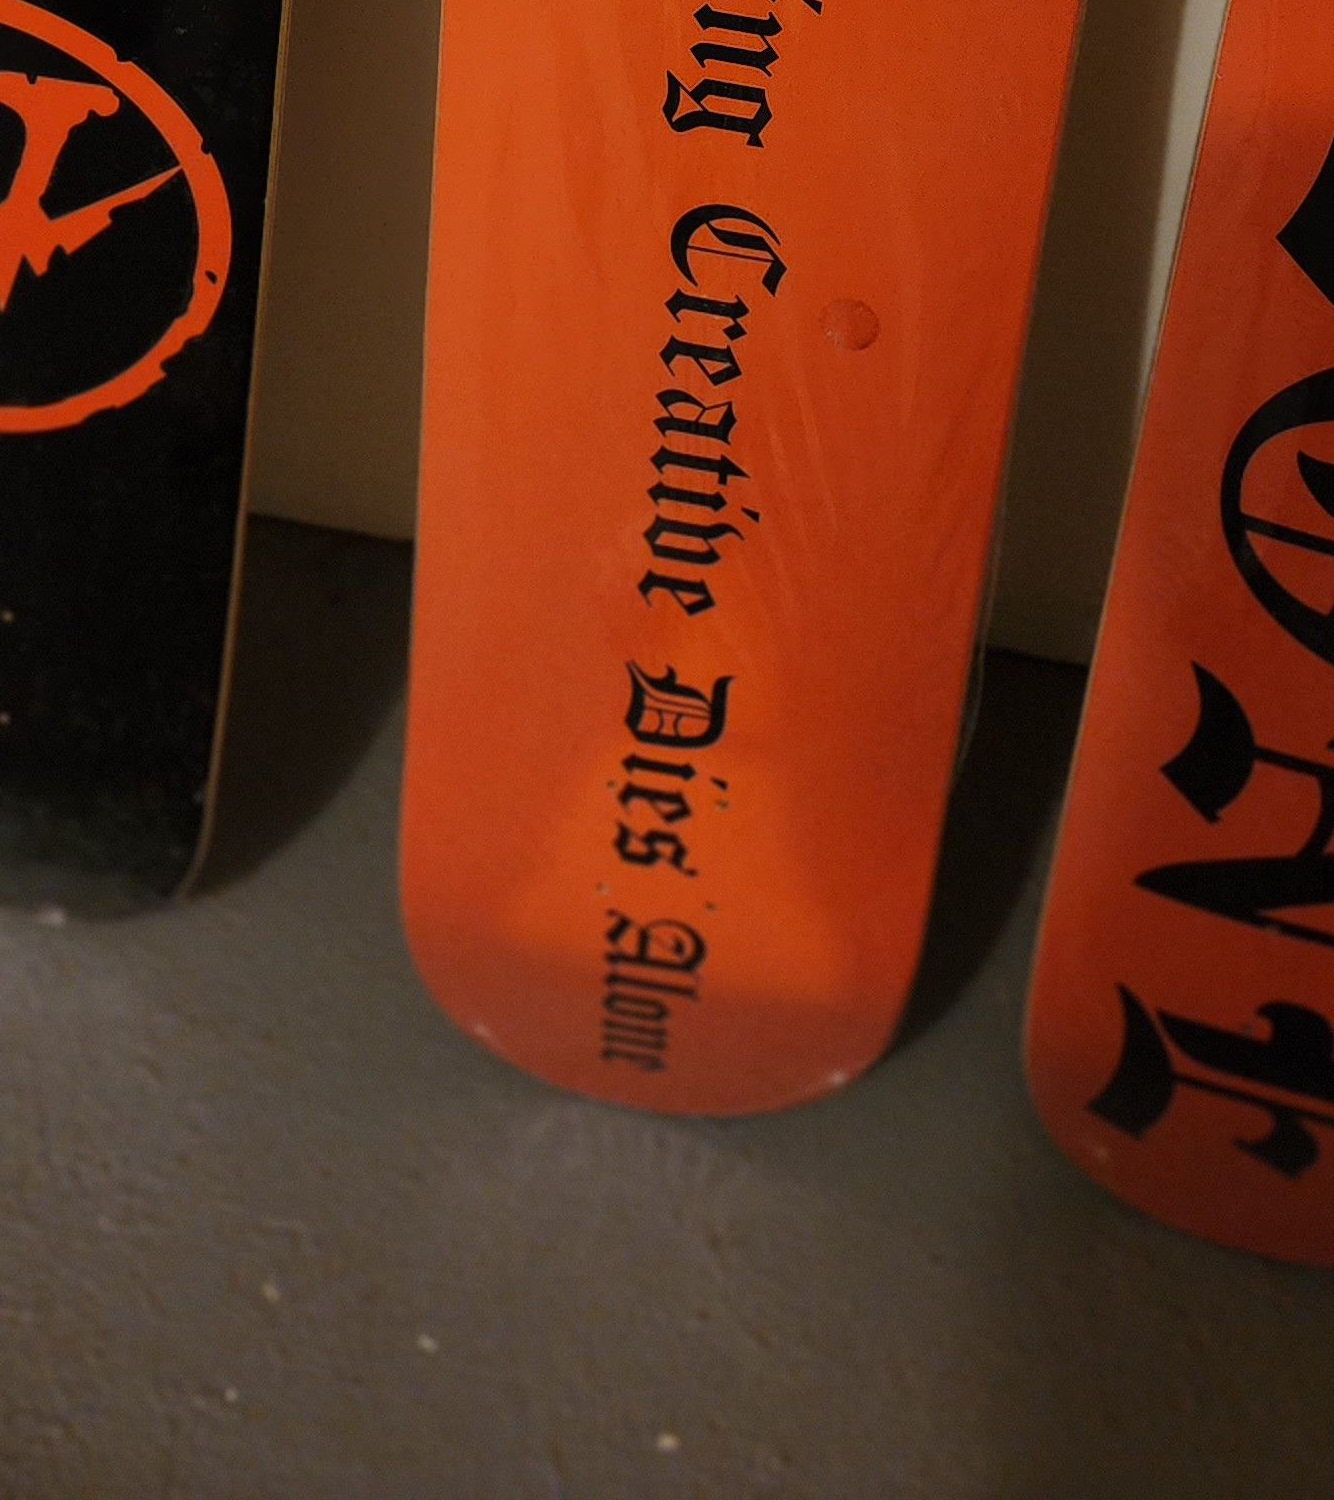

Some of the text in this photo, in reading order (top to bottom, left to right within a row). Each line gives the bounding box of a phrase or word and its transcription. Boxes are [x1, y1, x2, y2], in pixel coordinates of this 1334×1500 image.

[636, 203, 788, 617] Creative
[613, 659, 736, 878] Dies
[599, 908, 708, 1073] Alone
